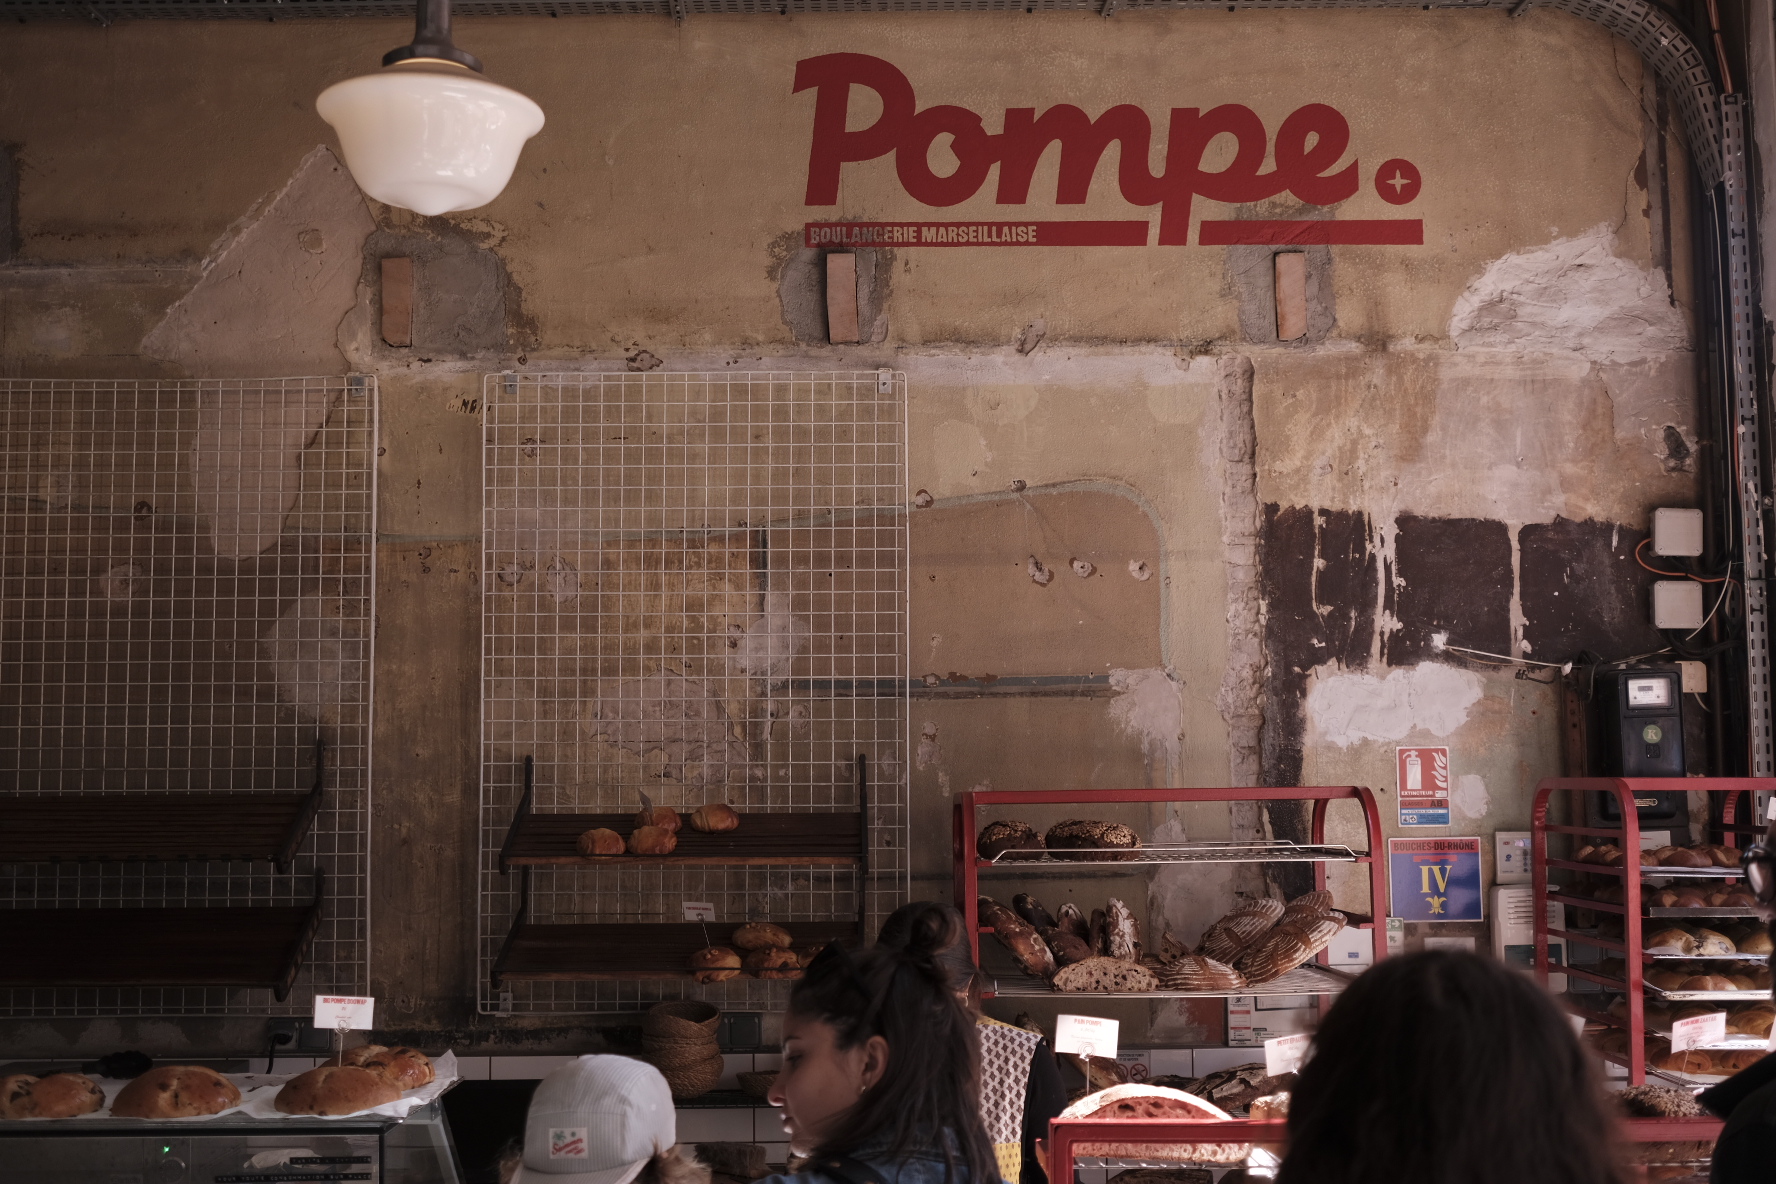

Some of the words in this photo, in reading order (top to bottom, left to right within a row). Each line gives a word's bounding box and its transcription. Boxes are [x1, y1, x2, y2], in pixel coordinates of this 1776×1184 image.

[810, 225, 917, 244] BOULANGERIE
[921, 225, 1037, 243] MARSEILLAISE
[1647, 729, 1657, 740] K
[1430, 799, 1443, 808] AB
[1393, 839, 1475, 851] BOUCHES-DU-RHÔNE
[1419, 865, 1453, 893] IV
